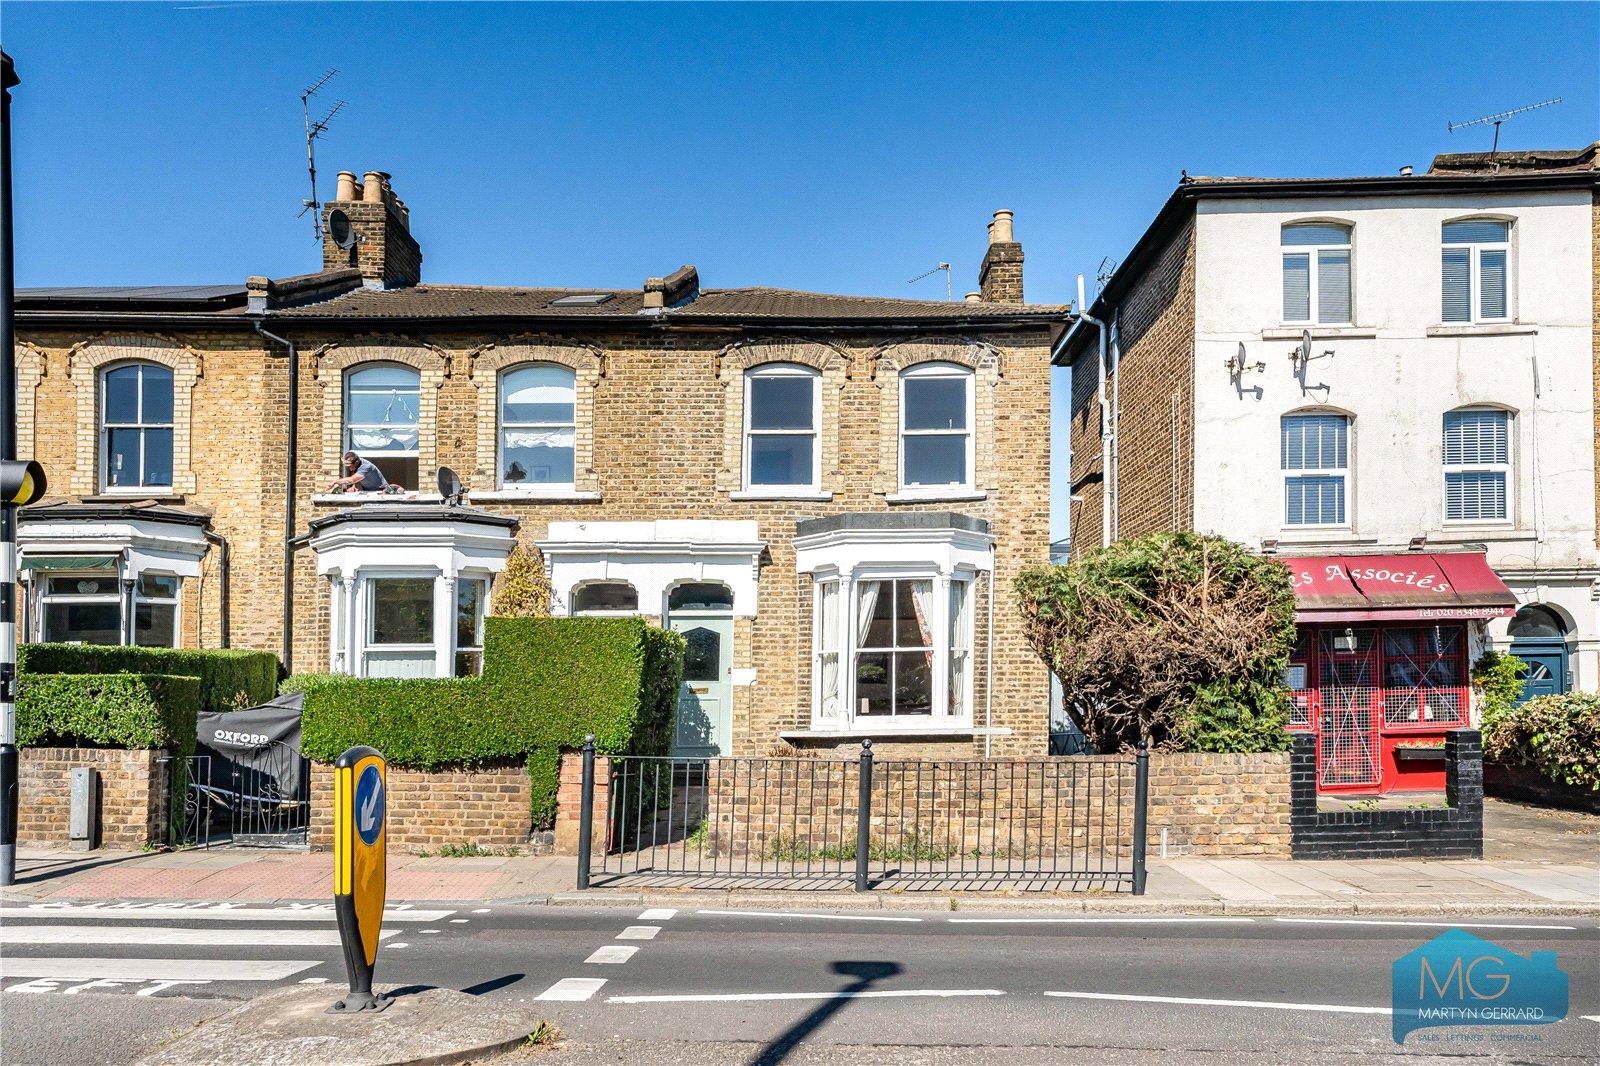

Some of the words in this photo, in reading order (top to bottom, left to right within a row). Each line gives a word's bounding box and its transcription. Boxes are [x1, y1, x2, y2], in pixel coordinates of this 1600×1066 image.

[1325, 564, 1450, 592] Associés
[1436, 607, 1454, 617] 020
[1456, 606, 1479, 616] 8348
[1481, 606, 1505, 616] 8944
[214, 730, 268, 744] OXFORD
[0, 977, 213, 996] EFT
